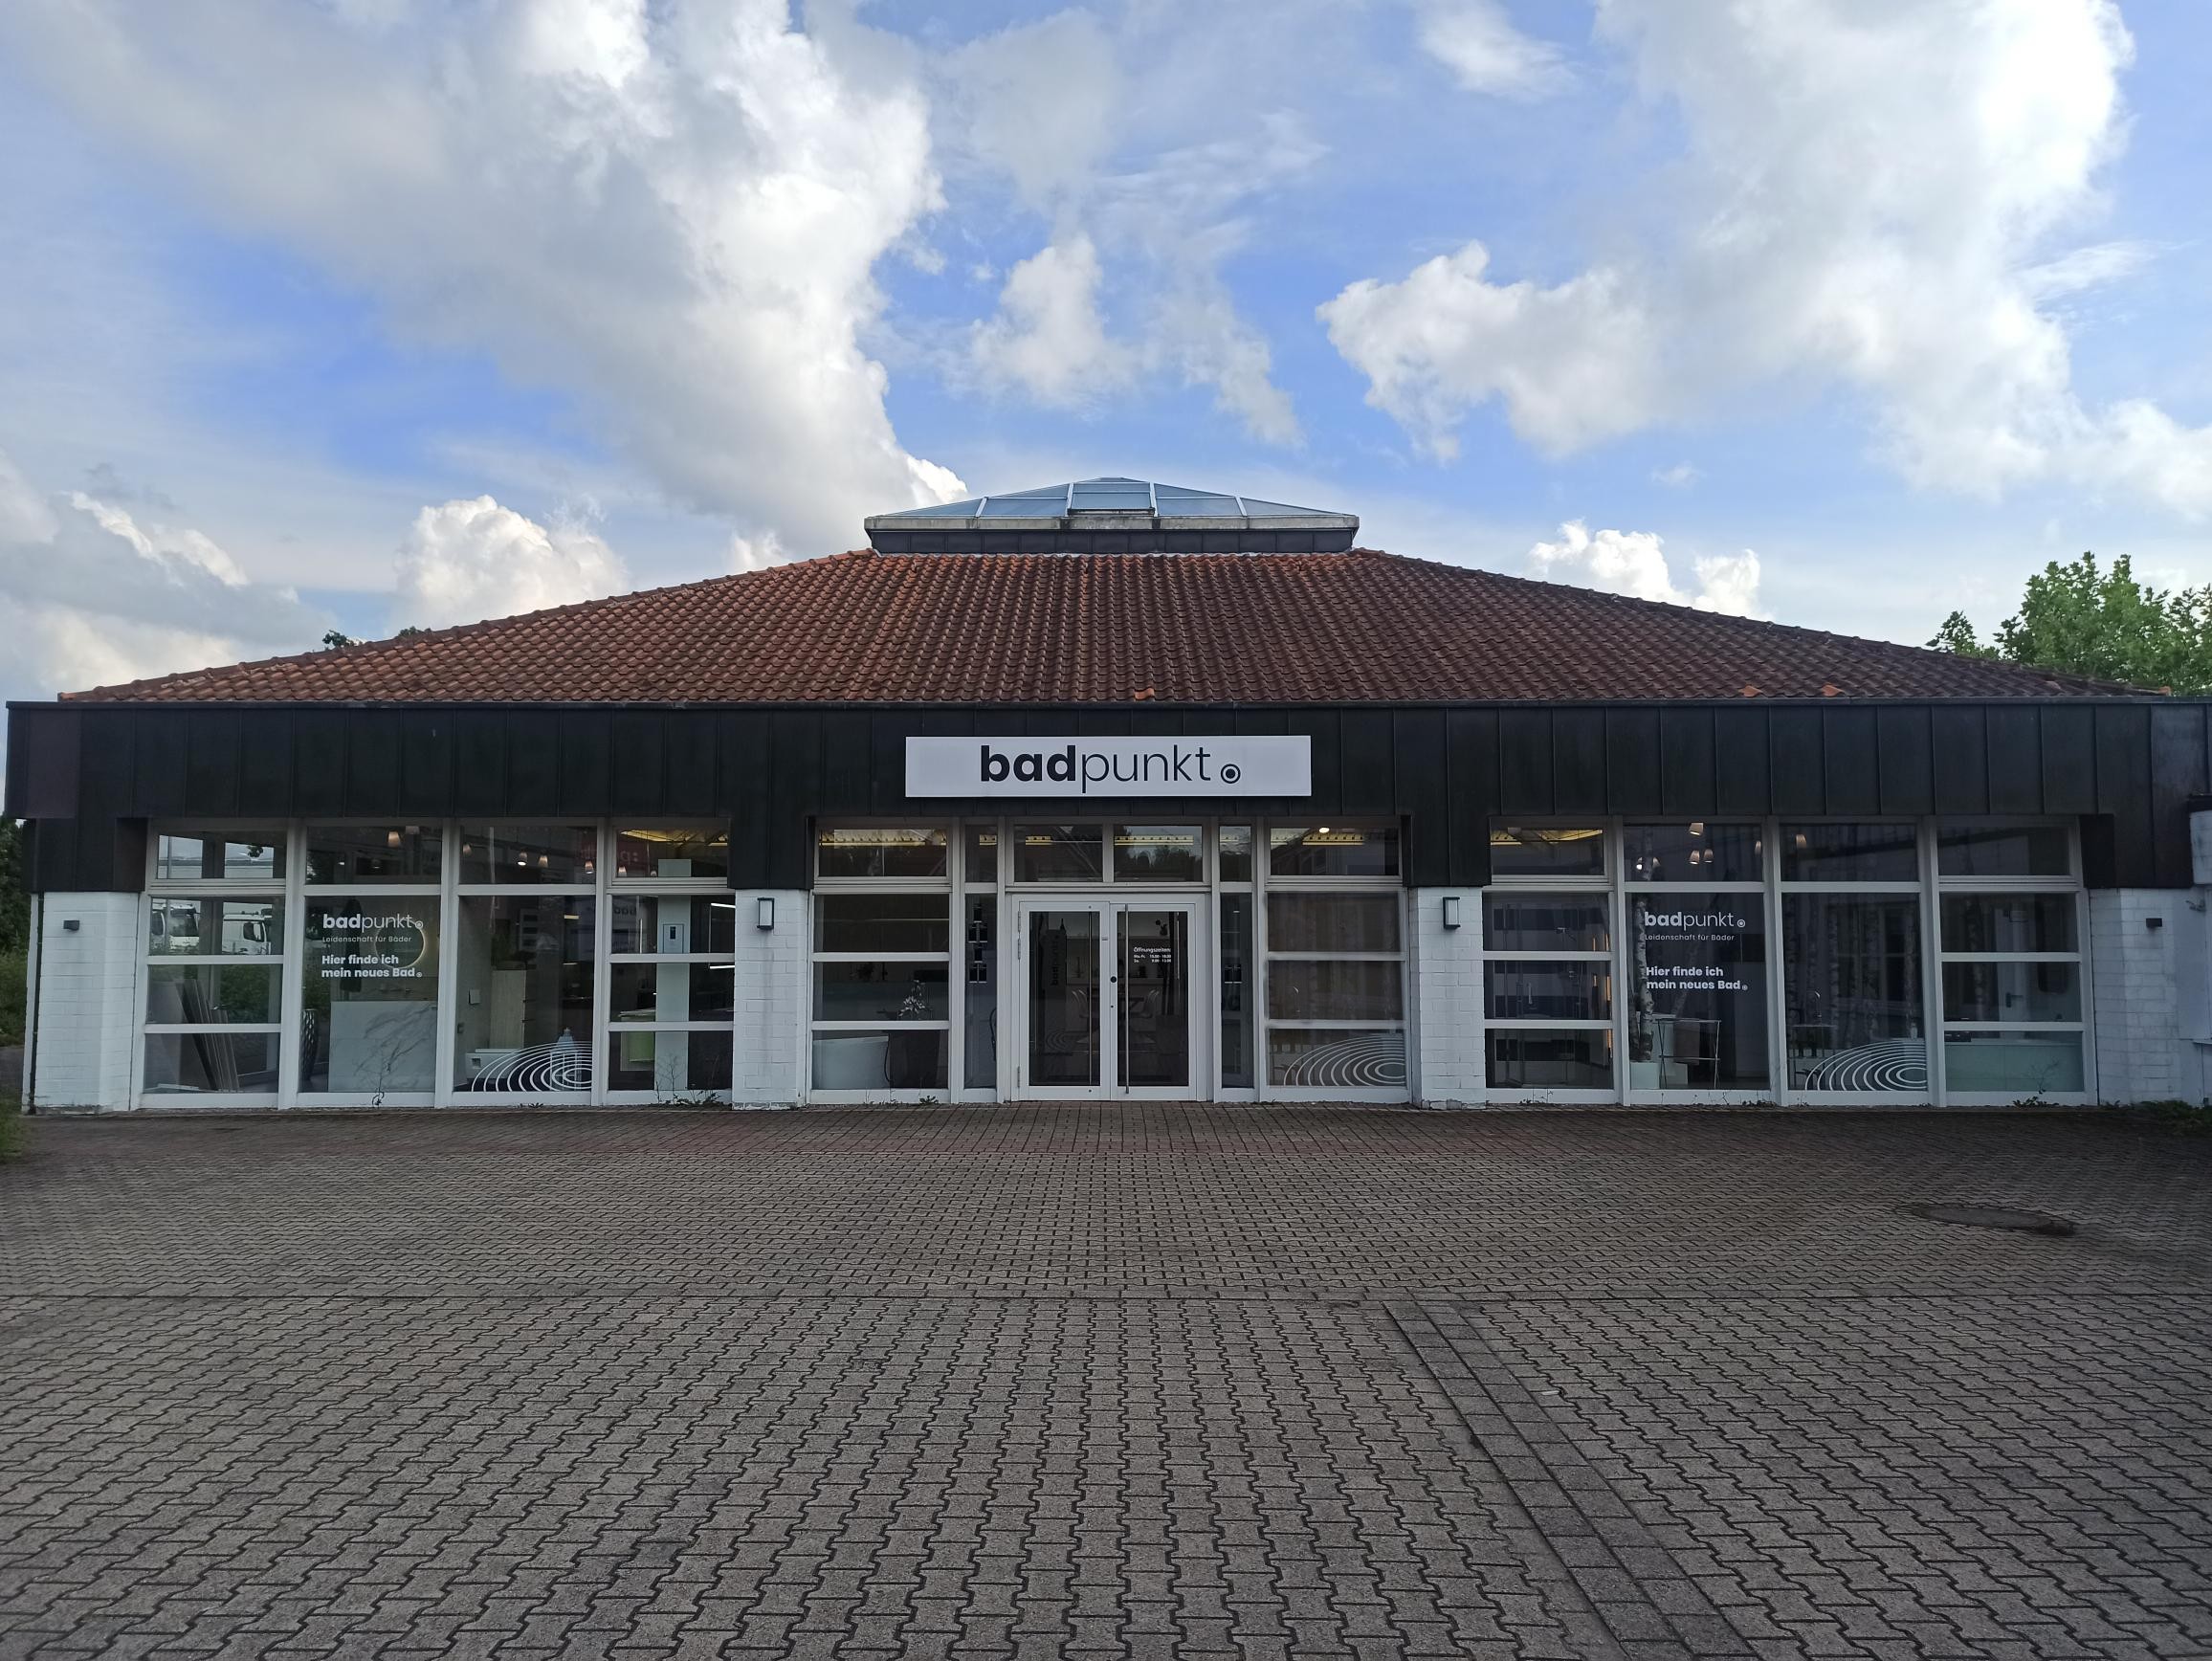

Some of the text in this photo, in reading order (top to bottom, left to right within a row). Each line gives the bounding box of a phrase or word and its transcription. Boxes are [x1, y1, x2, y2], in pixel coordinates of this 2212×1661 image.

[981, 744, 1211, 793] badpunkt
[322, 913, 412, 933] badpunkt
[1644, 911, 1735, 931] badpunkt
[321, 954, 399, 964] Hier finde ich
[321, 967, 352, 978] mein
[354, 967, 389, 978] neues
[1646, 966, 1724, 977] Hier finde ich
[1646, 979, 1676, 989] mein
[1679, 979, 1714, 989] neues
